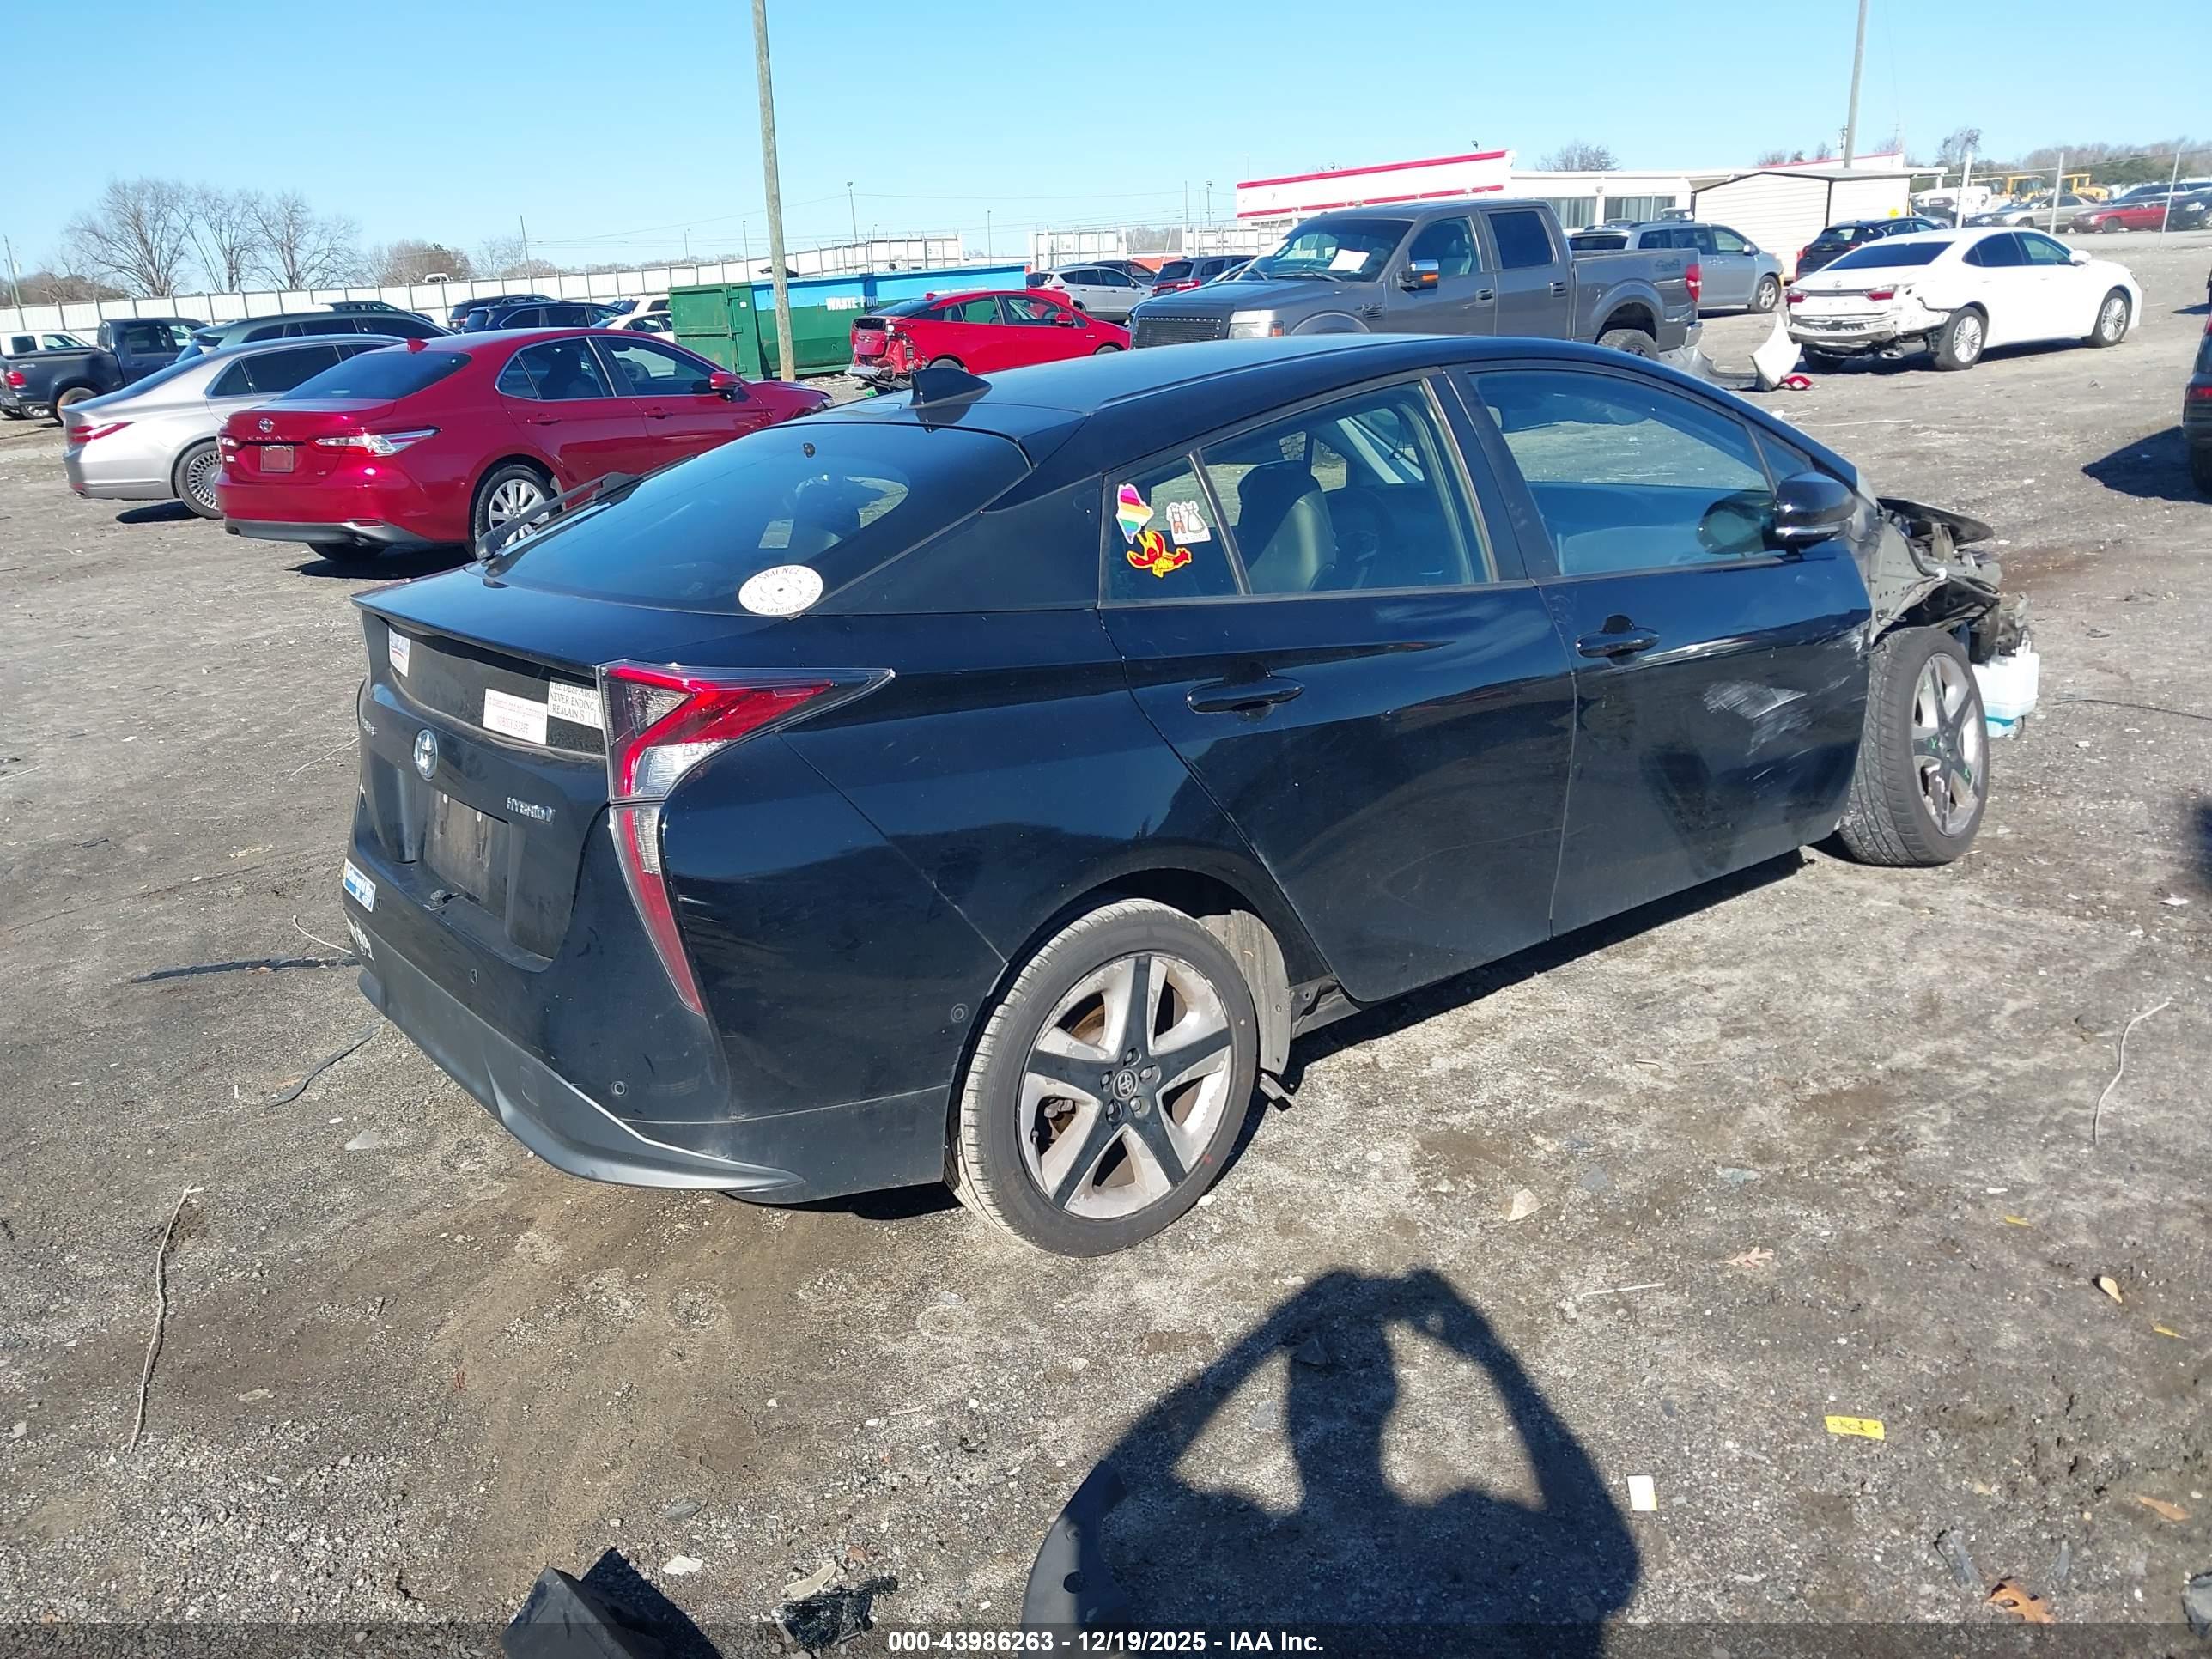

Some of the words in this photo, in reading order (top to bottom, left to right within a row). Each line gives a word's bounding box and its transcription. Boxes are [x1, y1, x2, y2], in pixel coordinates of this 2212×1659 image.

[825, 296, 857, 311] WASTE
[550, 691, 570, 704] NEVER
[552, 705, 579, 720] REMAIN
